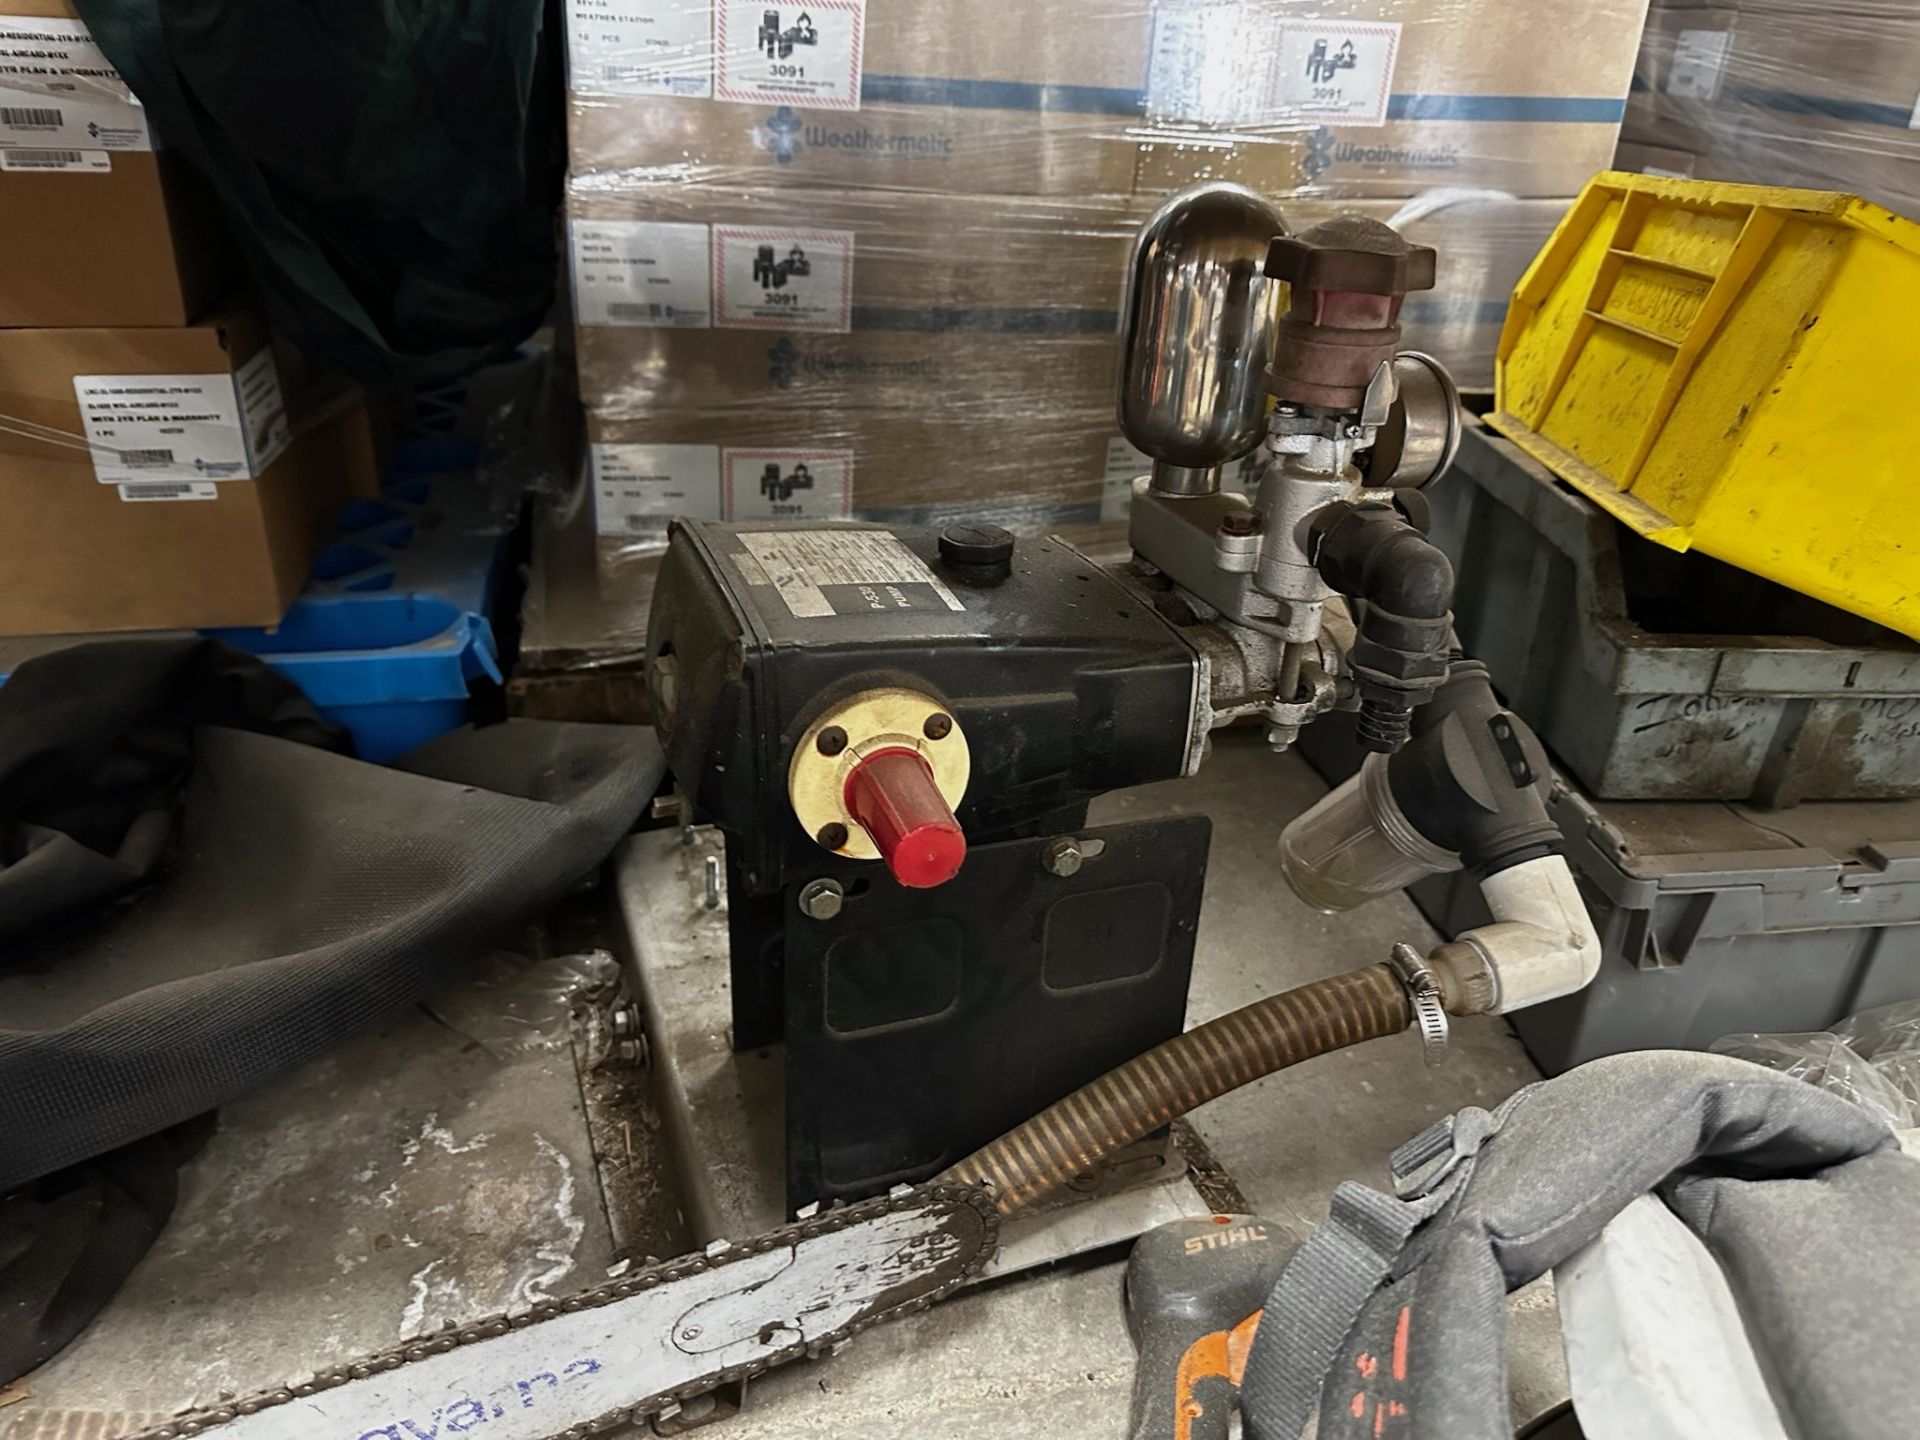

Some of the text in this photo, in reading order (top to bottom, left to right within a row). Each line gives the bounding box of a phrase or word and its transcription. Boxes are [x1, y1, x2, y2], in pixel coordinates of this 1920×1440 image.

[576, 13, 655, 24] WEATHER STATION
[602, 34, 620, 43] PCS
[20, 66, 47, 75] PLAN
[60, 67, 116, 78] WARRANTY
[769, 64, 805, 78] 3091
[1312, 88, 1342, 100] 3091
[805, 126, 953, 152] Weathermatic
[1335, 142, 1458, 166] Weathermatic
[764, 293, 798, 305] 3091
[771, 504, 803, 516] 3091
[885, 585, 912, 608] PUMP
[1184, 1225, 1268, 1256] STIHL
